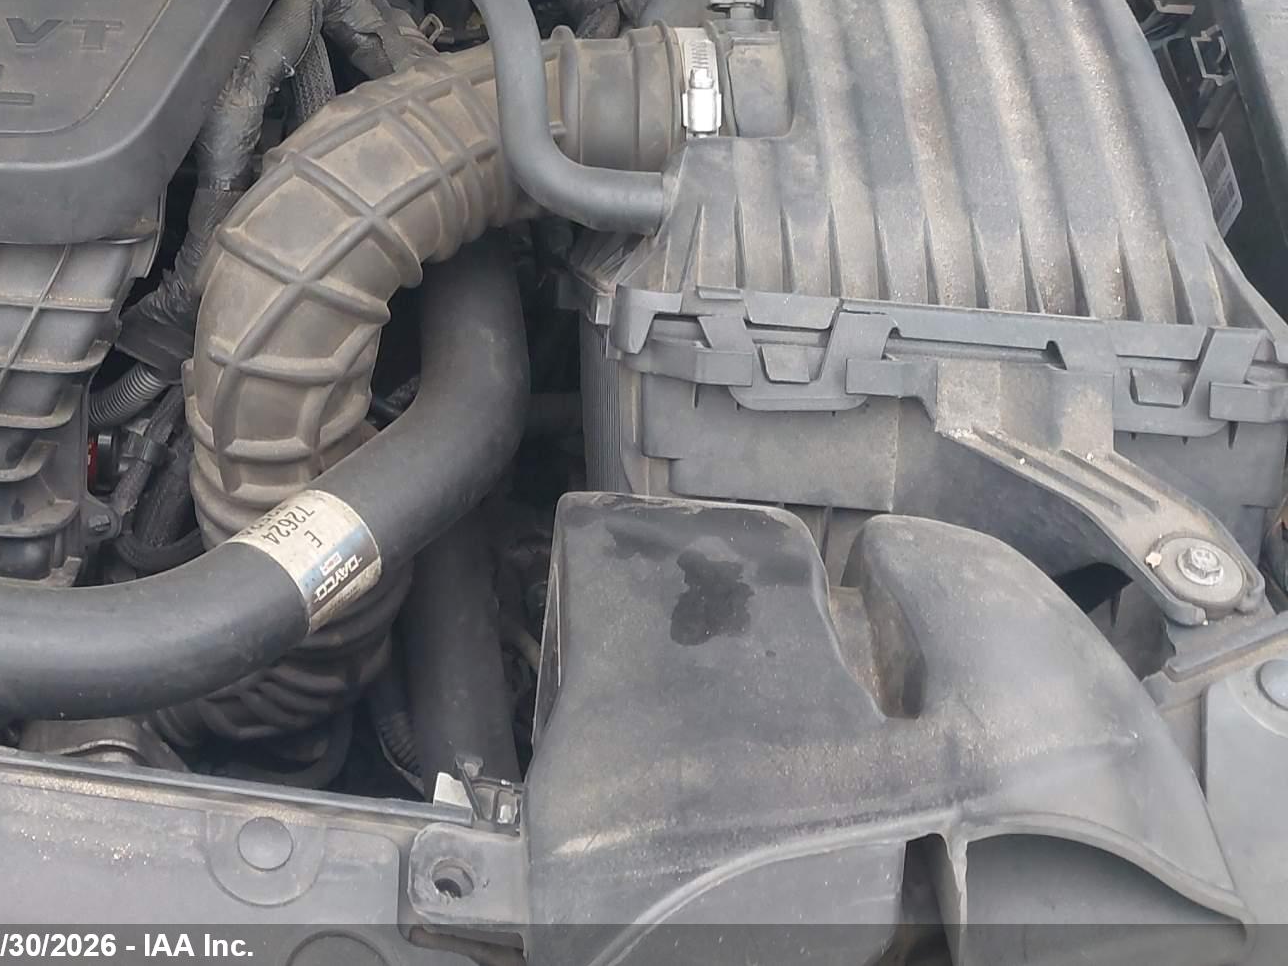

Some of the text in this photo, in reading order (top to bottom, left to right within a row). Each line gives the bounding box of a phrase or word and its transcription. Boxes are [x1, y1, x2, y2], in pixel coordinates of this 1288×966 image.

[263, 505, 316, 546] 72624
[303, 529, 323, 549] E
[314, 554, 360, 602] DAYCO
